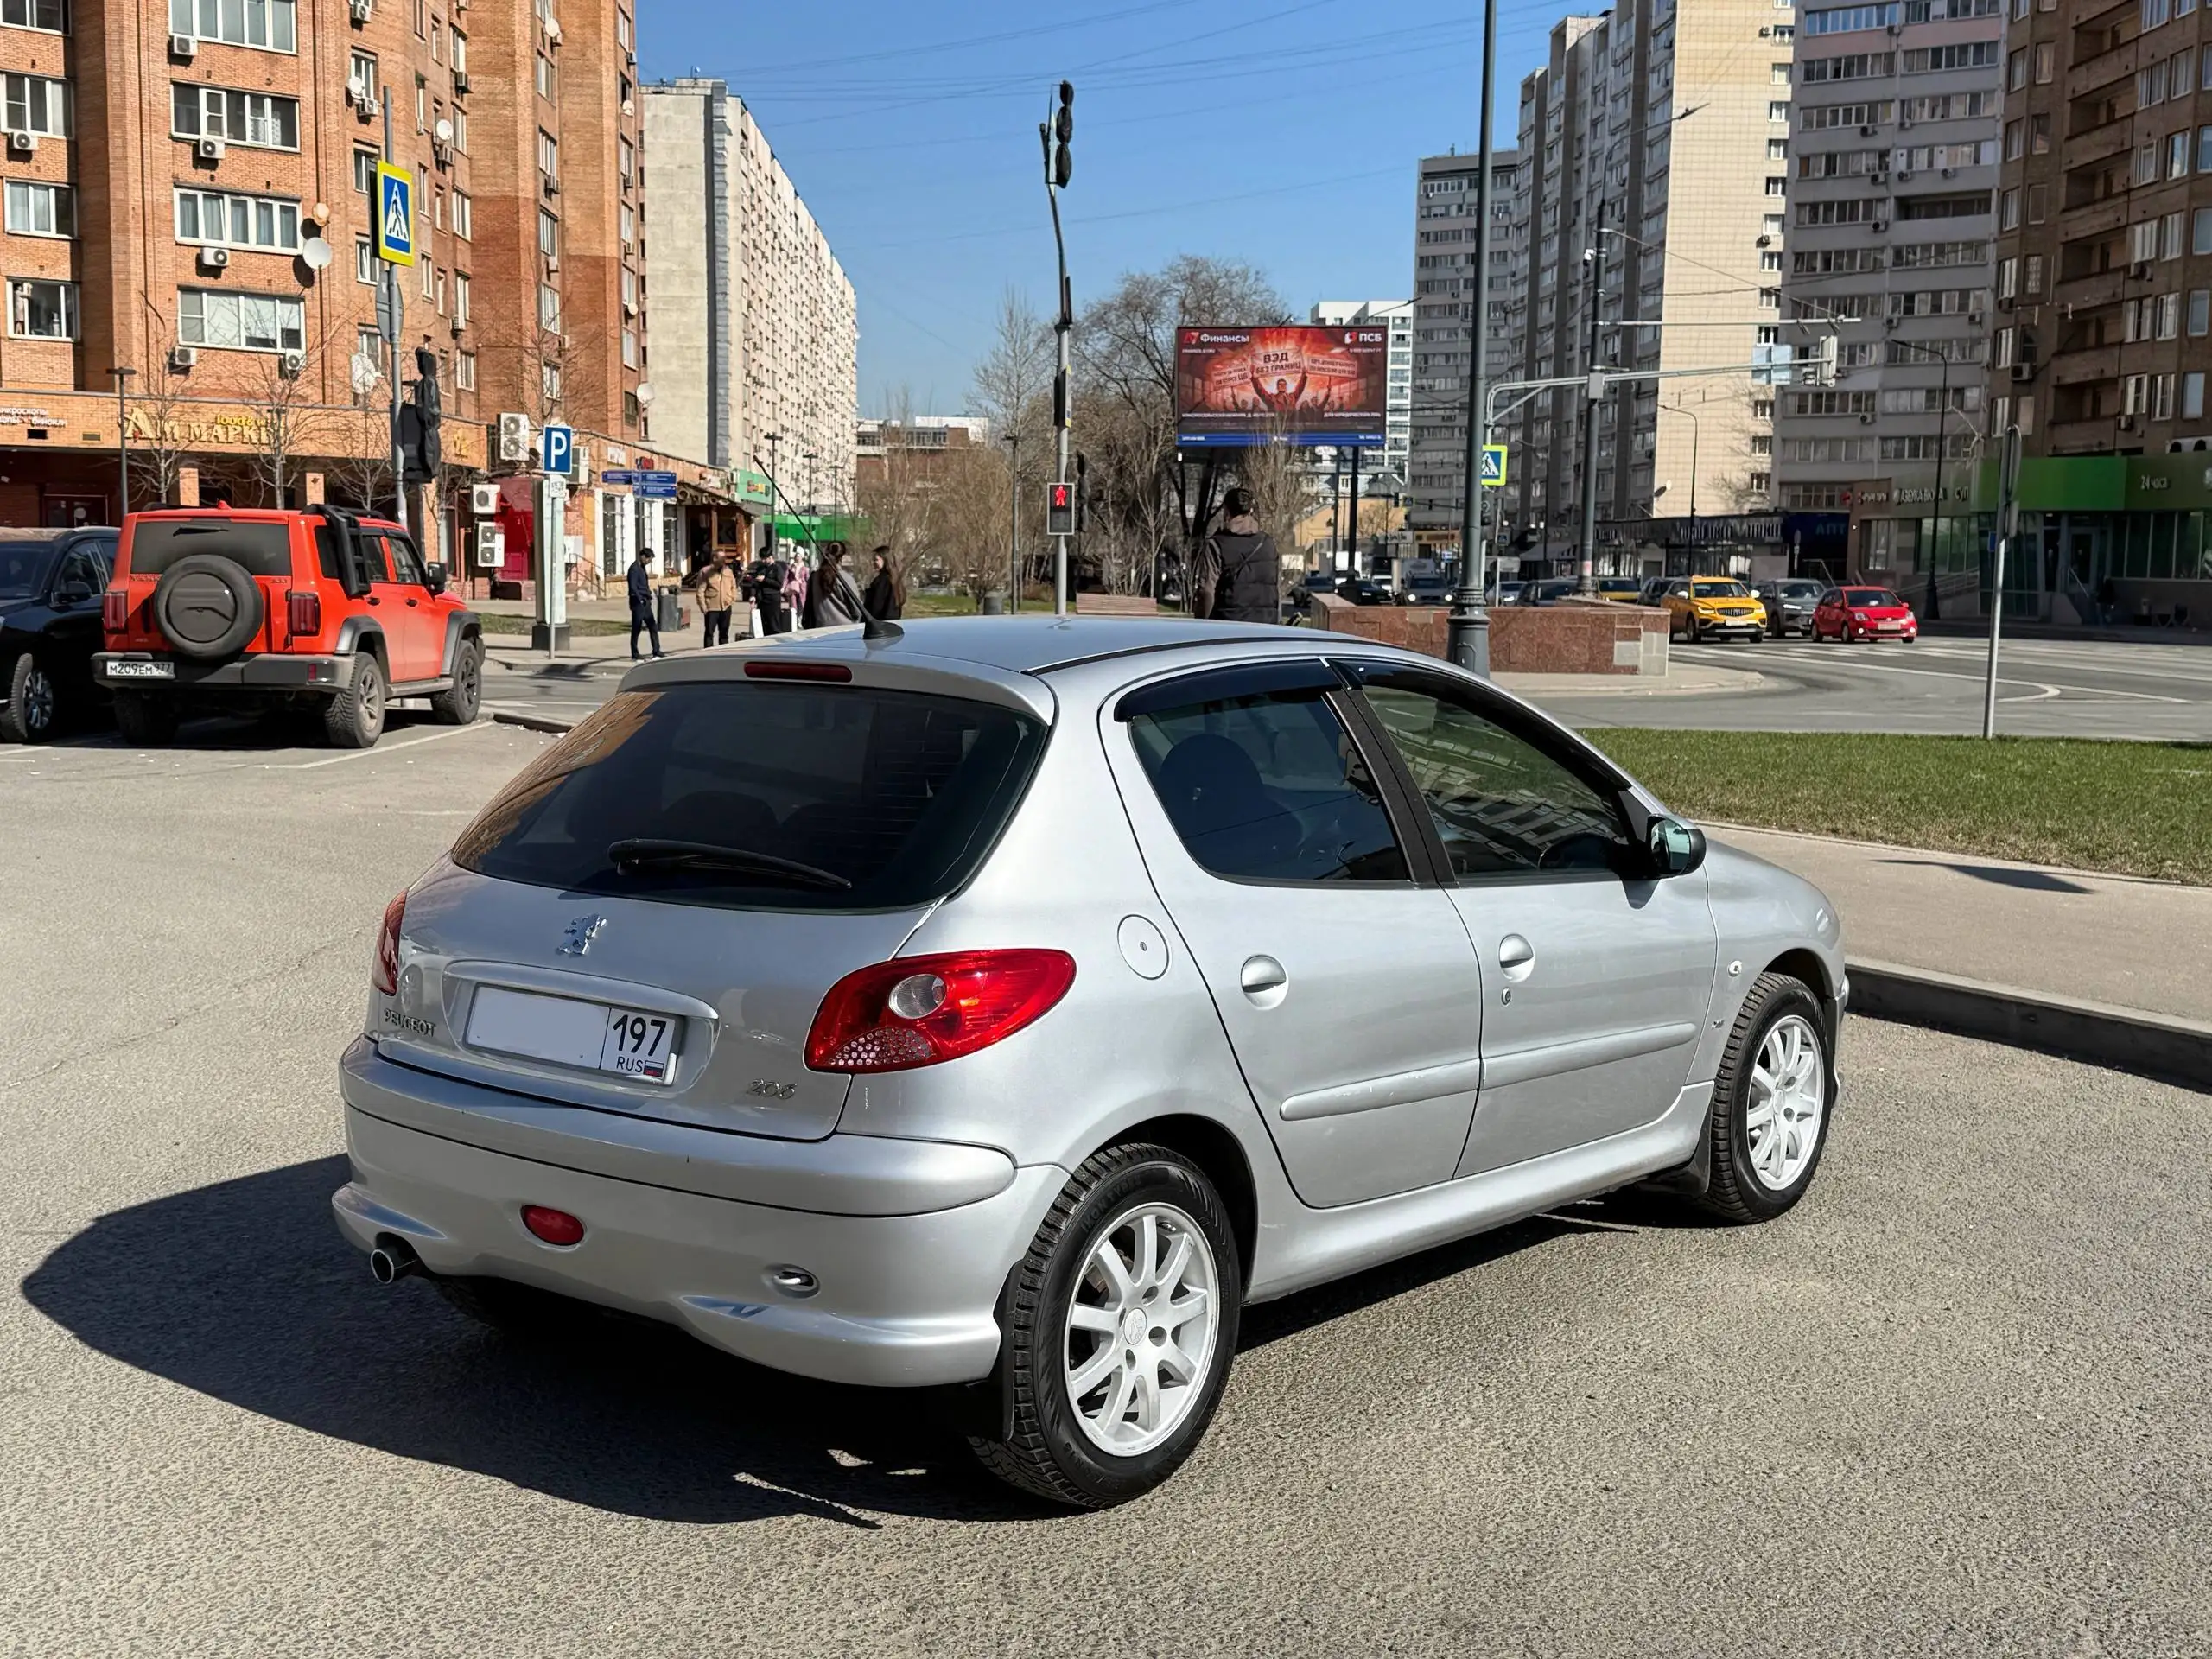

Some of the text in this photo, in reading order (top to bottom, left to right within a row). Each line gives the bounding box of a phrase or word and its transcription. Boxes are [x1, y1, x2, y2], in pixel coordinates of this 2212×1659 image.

[1200, 334, 1250, 343] Финансы
[1359, 333, 1382, 342] ПСБ
[1263, 352, 1288, 363] ВЭД
[1255, 365, 1268, 374] БЕЗ
[1271, 362, 1301, 372] ГРАНИЦ
[550, 431, 567, 468] P
[384, 1008, 435, 1038] PEUGEOT
[613, 1014, 667, 1057] 197
[616, 1056, 644, 1073] RUS
[750, 1078, 798, 1101] 206
